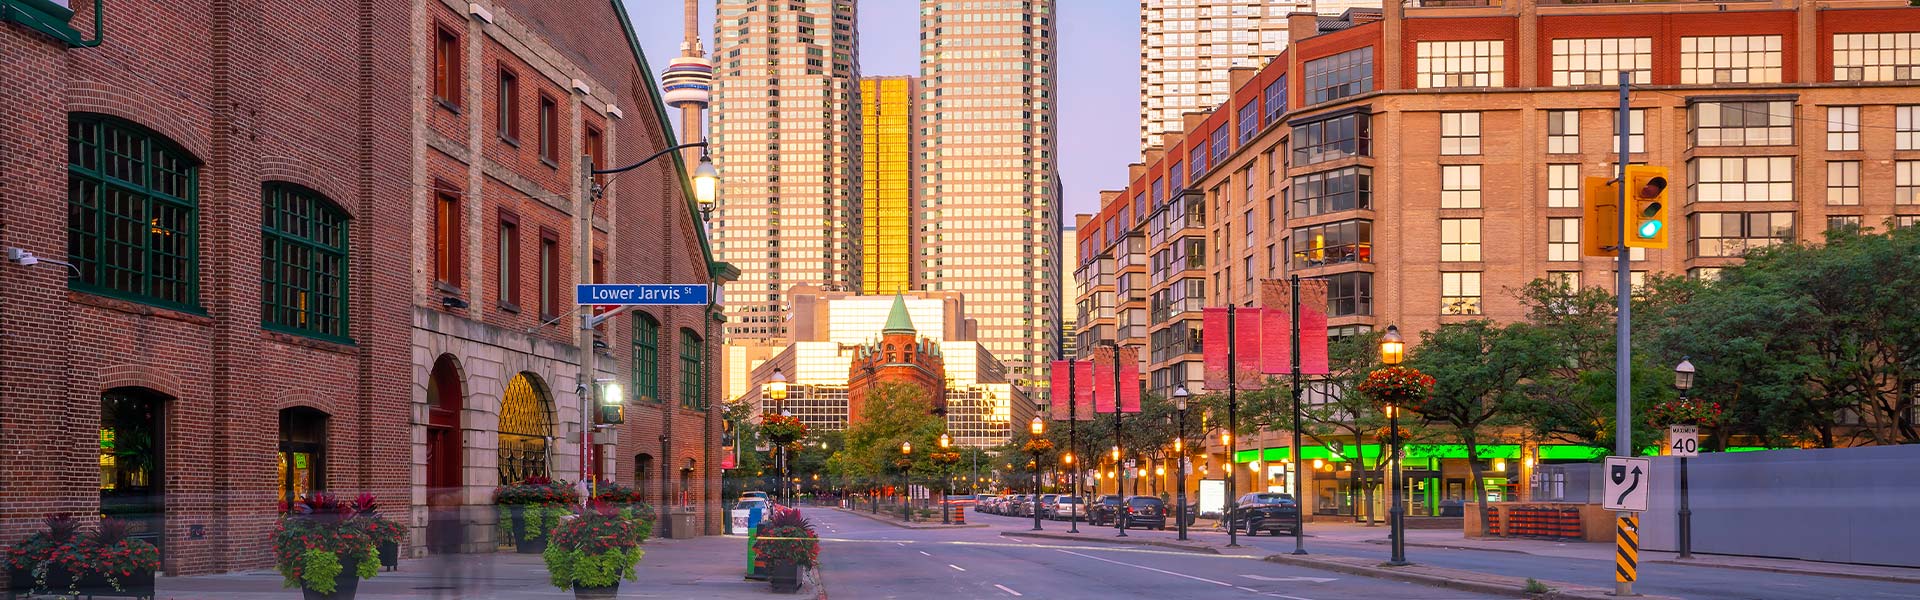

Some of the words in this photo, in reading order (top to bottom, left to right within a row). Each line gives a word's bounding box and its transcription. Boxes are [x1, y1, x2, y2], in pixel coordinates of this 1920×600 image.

[592, 286, 634, 300] Lower
[638, 286, 681, 300] Jarvis
[1672, 438, 1696, 453] 40
